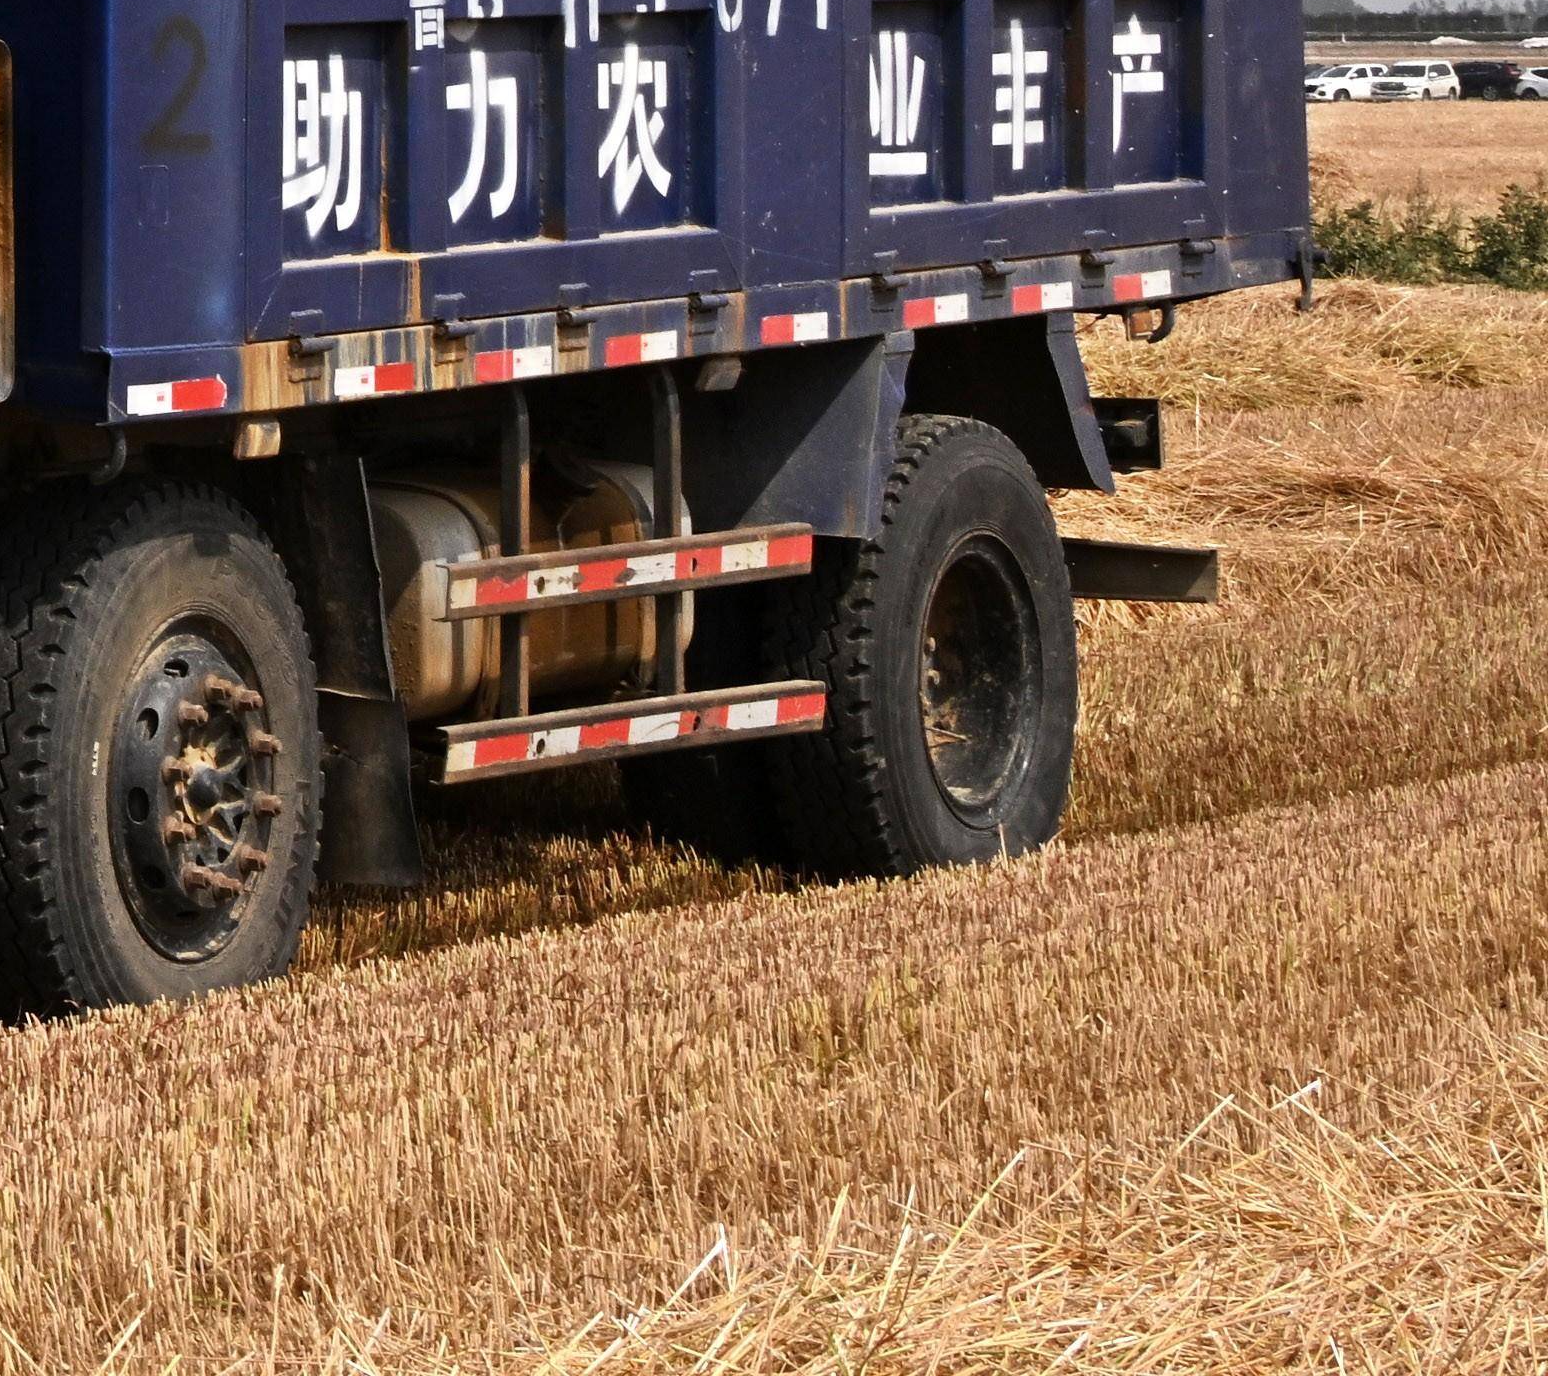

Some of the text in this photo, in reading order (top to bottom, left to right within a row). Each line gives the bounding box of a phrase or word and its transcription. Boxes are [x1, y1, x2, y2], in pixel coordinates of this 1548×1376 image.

[140, 14, 213, 155] 2
[282, 14, 1164, 238] 助力农业丰产
